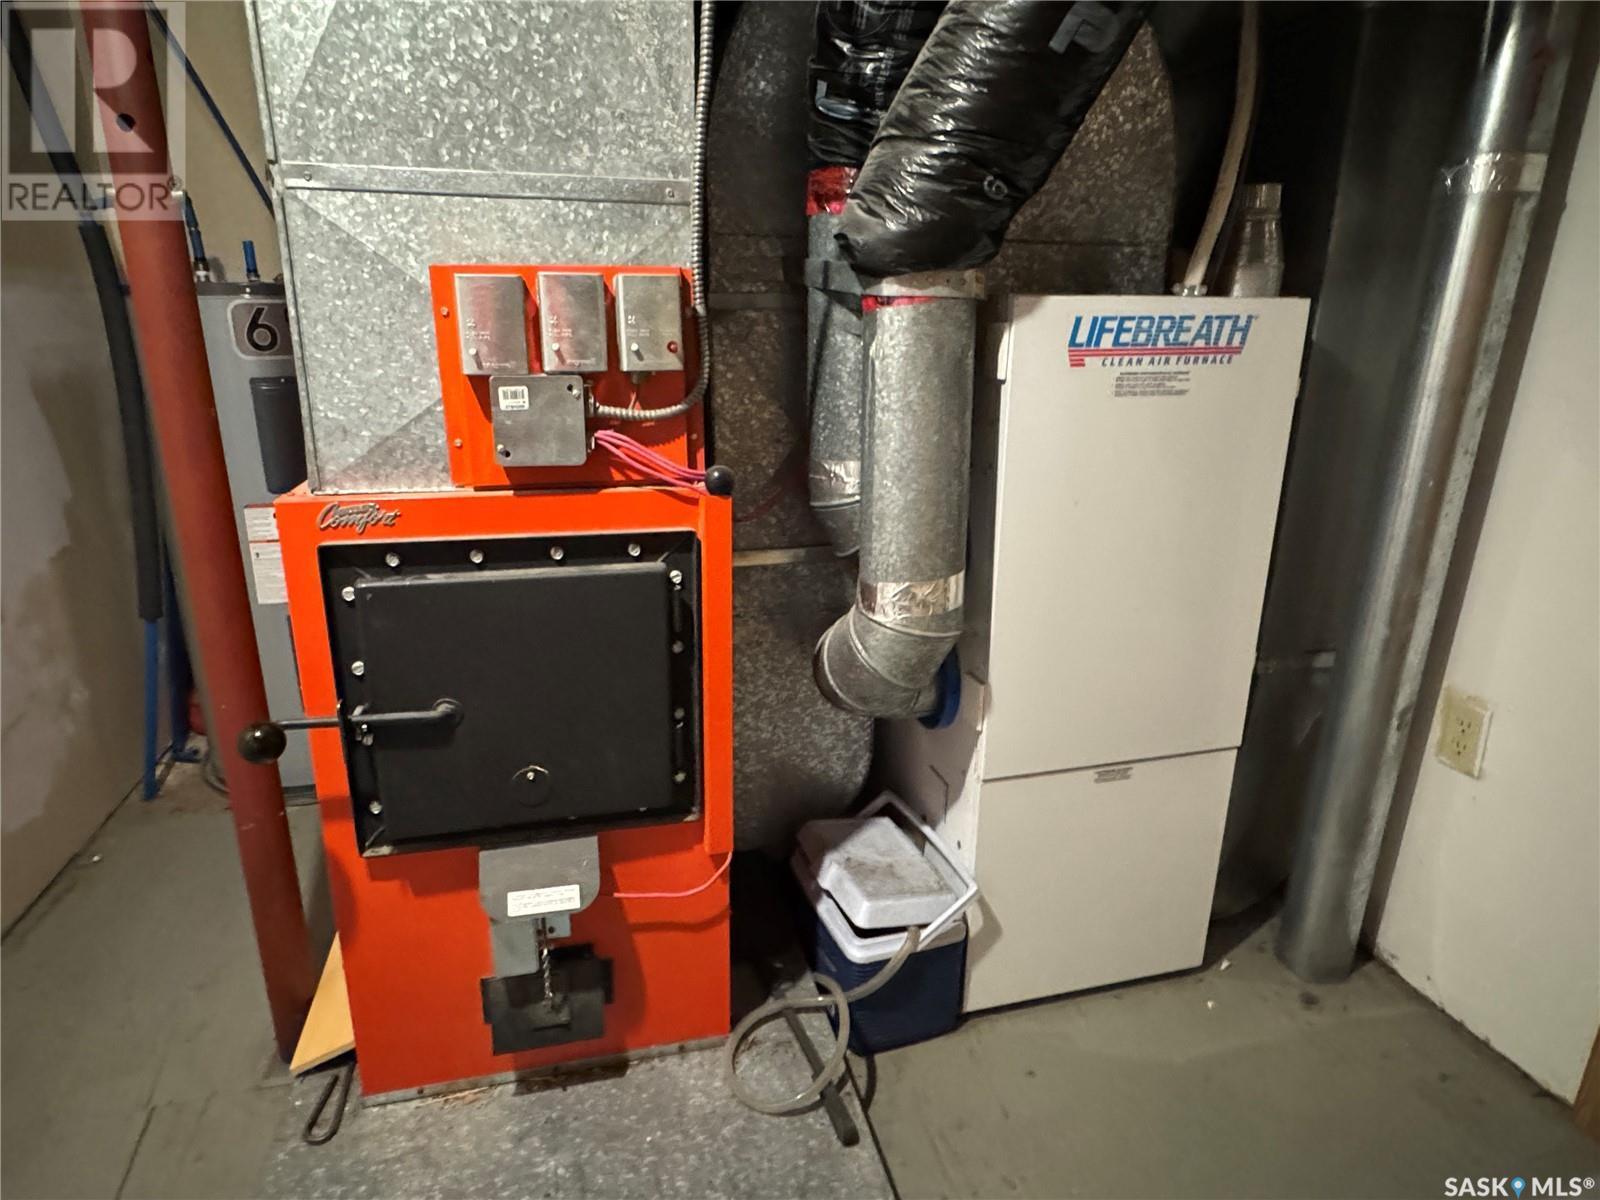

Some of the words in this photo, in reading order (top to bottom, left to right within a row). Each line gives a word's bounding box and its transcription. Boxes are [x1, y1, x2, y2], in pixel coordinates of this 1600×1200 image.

[1067, 314, 1253, 348] LIFEBREATH
[1101, 356, 1143, 368] CLEAN
[1148, 355, 1170, 367] AIR
[1175, 354, 1233, 366] FURNACE
